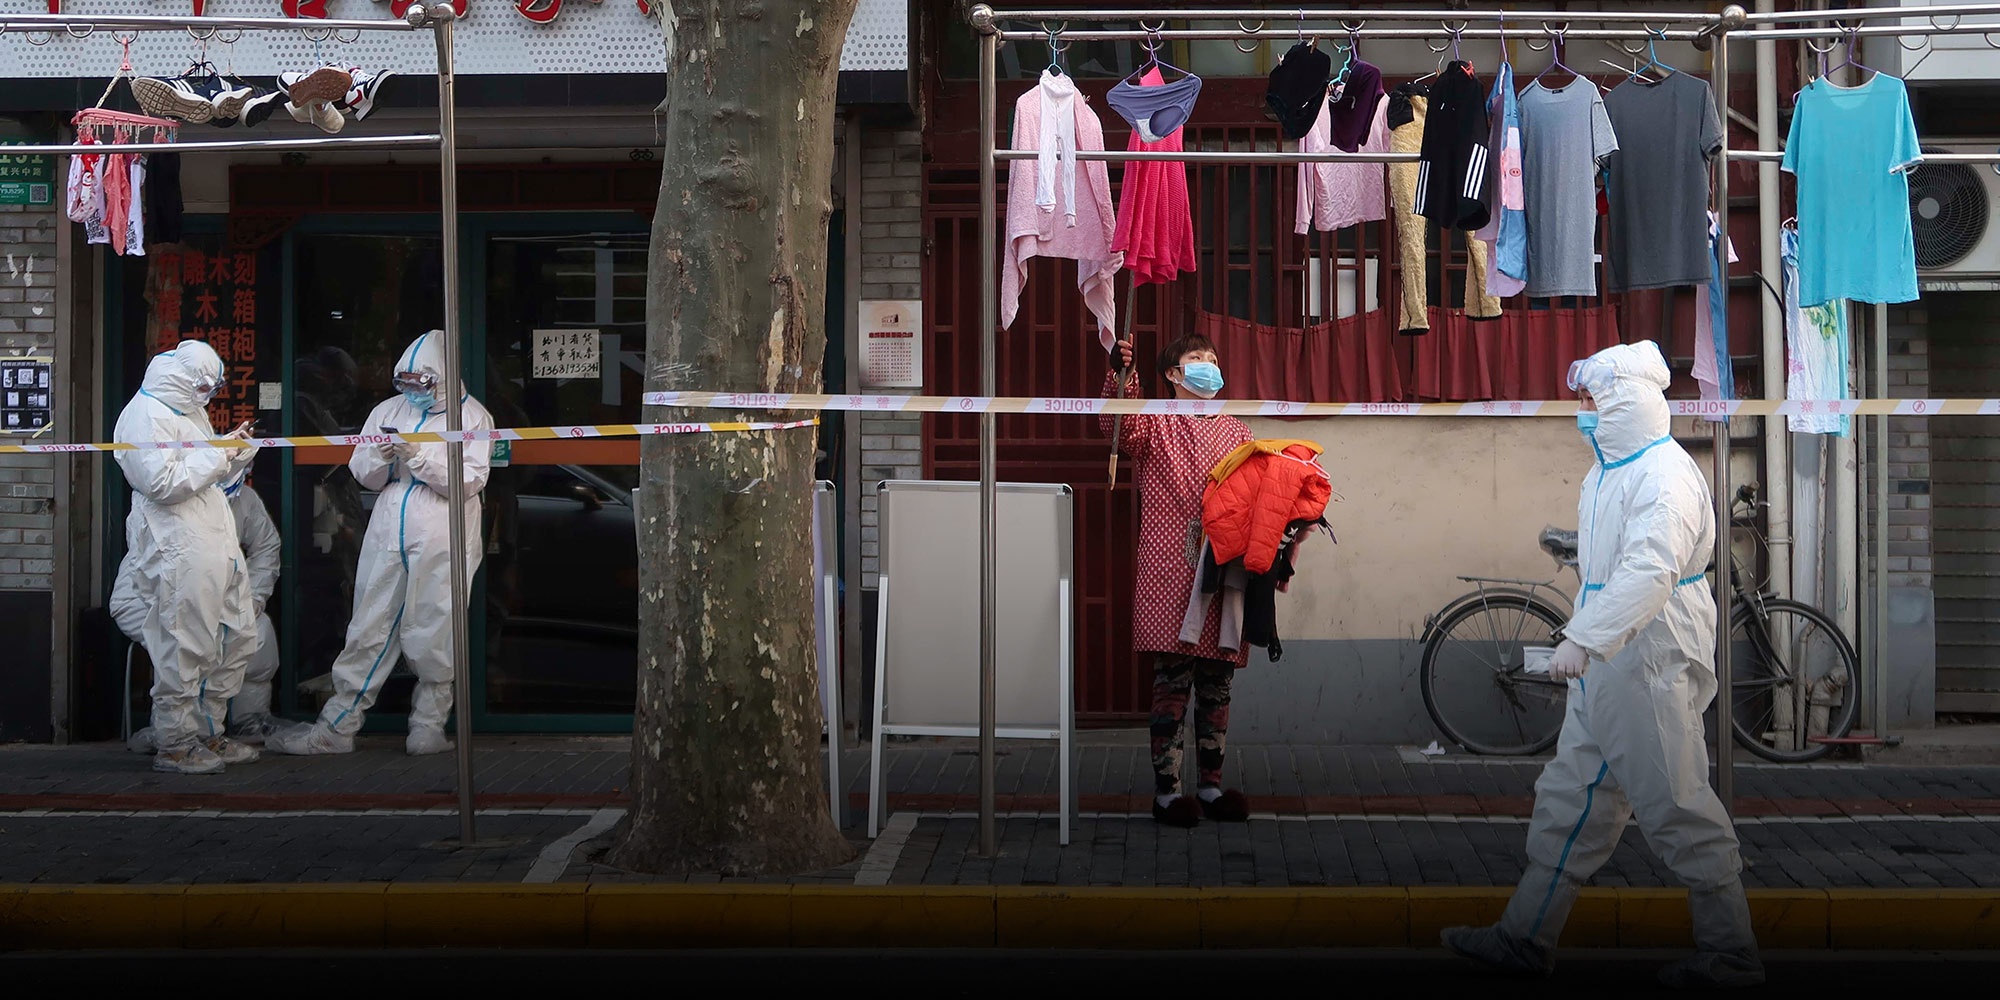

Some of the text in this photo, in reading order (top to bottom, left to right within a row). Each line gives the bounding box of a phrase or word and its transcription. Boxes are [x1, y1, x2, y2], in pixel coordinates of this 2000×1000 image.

[653, 424, 703, 434] POLICE
[344, 434, 392, 445] POLICE
[38, 444, 86, 452] POLICE
